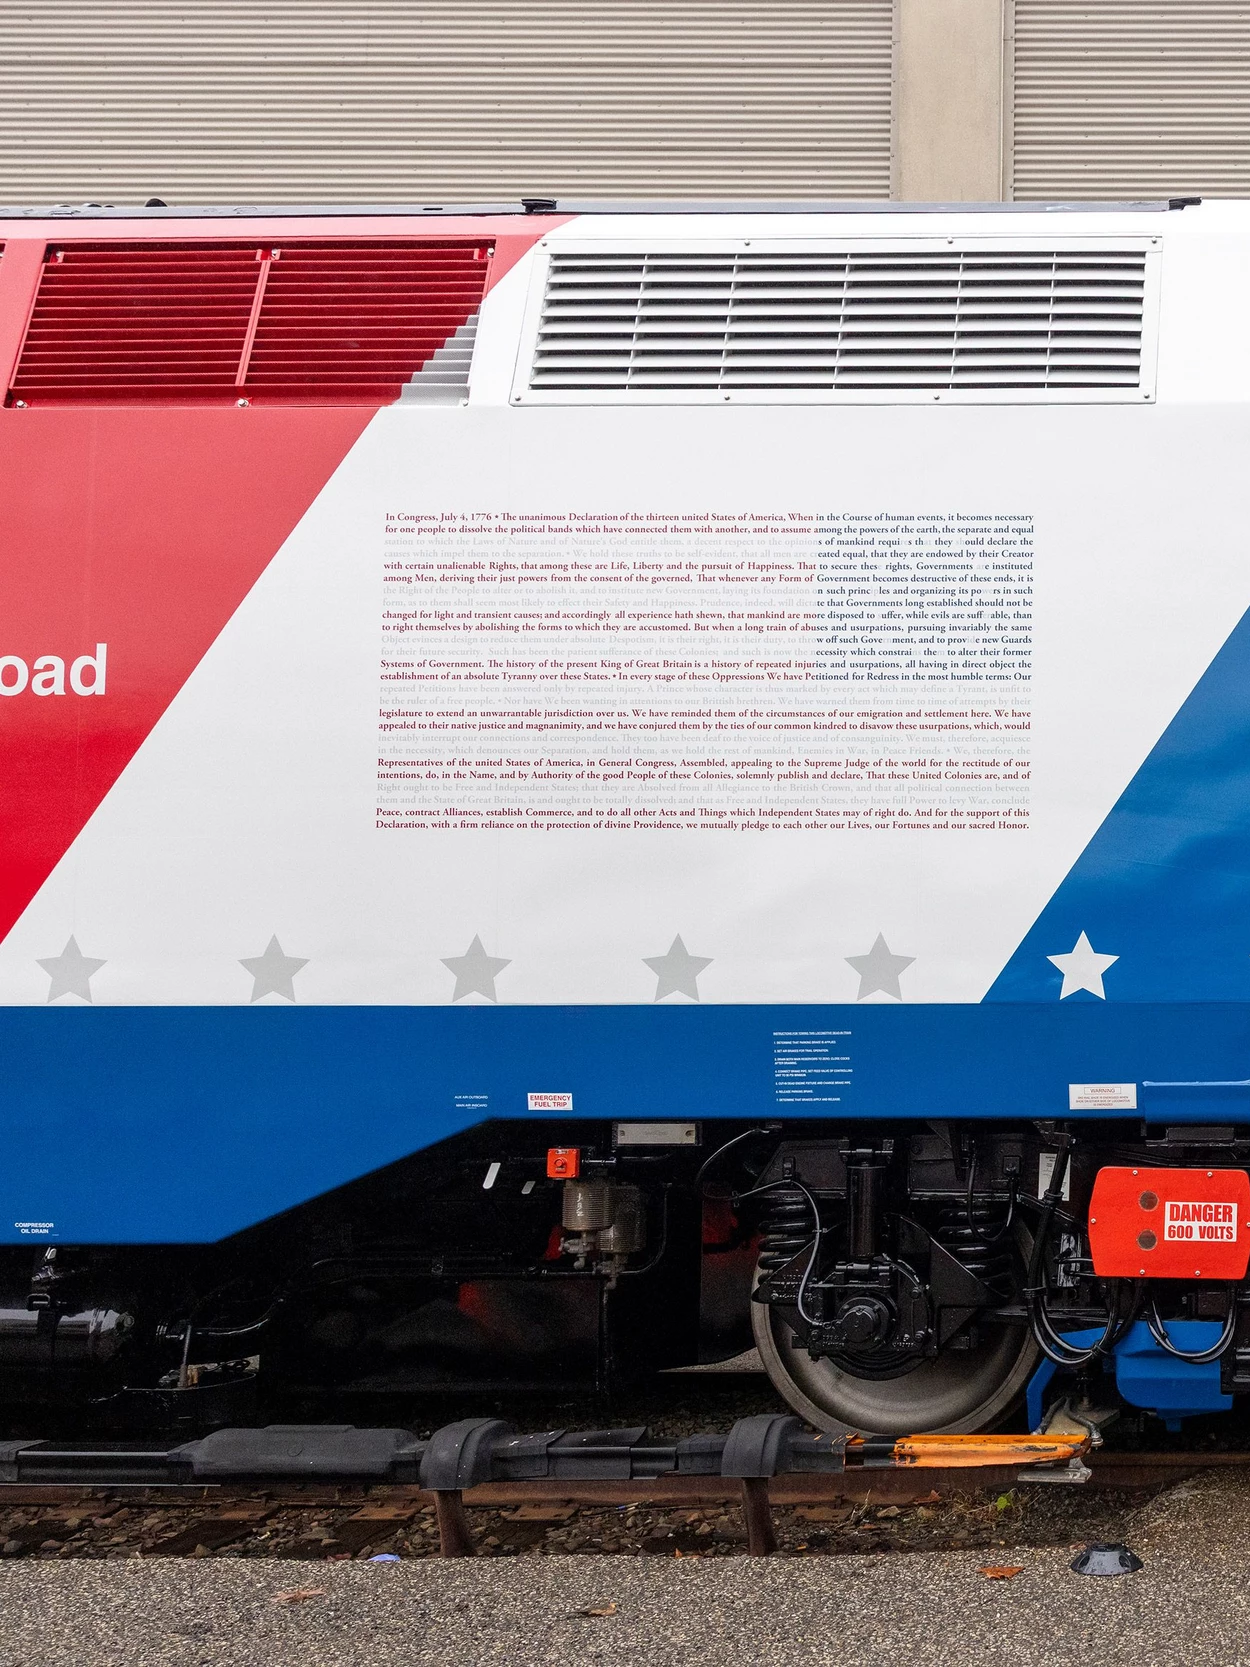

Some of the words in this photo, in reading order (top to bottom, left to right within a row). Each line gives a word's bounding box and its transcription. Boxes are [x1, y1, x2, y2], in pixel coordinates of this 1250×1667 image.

[397, 513, 438, 523] Congress,
[439, 512, 458, 523] July
[460, 513, 468, 521] 4,
[501, 512, 517, 521] The
[569, 512, 618, 521] Declaration
[619, 512, 630, 521] of
[630, 512, 644, 521] the
[646, 512, 679, 521] thirteen
[682, 512, 709, 521] united
[711, 513, 736, 521] States
[737, 512, 748, 521] of
[748, 513, 786, 522] America,
[788, 513, 813, 521] When
[816, 513, 824, 521] in
[827, 513, 840, 521] the
[842, 513, 873, 521] Course
[874, 512, 884, 521] of
[885, 513, 915, 521] human
[956, 513, 992, 521] becomes
[380, 672, 439, 680] establishment
[440, 671, 451, 680] of
[464, 672, 500, 680] absolute
[501, 672, 538, 682] Tyranny
[560, 672, 582, 680] these
[583, 672, 611, 680] States.
[619, 672, 628, 680] In
[654, 674, 676, 683] stage
[677, 672, 688, 680] of
[688, 672, 710, 680] these
[712, 672, 765, 683] Oppressions
[766, 672, 781, 680] We
[783, 672, 803, 680] have
[805, 672, 849, 681] Petitioned
[852, 672, 865, 680] for
[867, 672, 899, 681] Redress
[912, 672, 926, 681] the
[951, 672, 983, 681] humble
[1013, 672, 1032, 680] Our
[378, 758, 443, 769] Representatives
[446, 758, 457, 766] of
[458, 758, 472, 766] the
[475, 758, 503, 767] united
[505, 758, 531, 767] States
[533, 758, 544, 767] of
[545, 758, 583, 767] America,
[586, 758, 595, 767] in
[598, 758, 632, 767] General
[635, 758, 677, 770] Congress,
[680, 758, 728, 767] Assembled,
[731, 758, 773, 769] appealing
[788, 758, 801, 767] the
[804, 758, 842, 769] Supreme
[844, 758, 870, 770] Judge
[872, 758, 883, 767] of
[885, 758, 899, 767] the
[901, 758, 926, 767] world
[930, 758, 943, 767] for
[945, 758, 959, 767] the
[962, 758, 1000, 767] rectitude
[1003, 758, 1014, 767] of
[376, 820, 429, 829] Declaration,
[431, 820, 450, 828] with
[460, 820, 478, 828] firm
[481, 820, 514, 829] reliance
[530, 820, 544, 829] the
[546, 821, 591, 831] protection
[593, 820, 604, 829] of
[604, 820, 631, 829] divine
[633, 820, 684, 829] Providence,
[700, 820, 739, 831] mutually
[741, 820, 769, 832] pledge
[783, 820, 802, 829] each
[804, 820, 828, 829] other
[848, 821, 872, 830] Lives,
[892, 821, 930, 829] Fortunes
[932, 820, 949, 829] and
[969, 821, 995, 829] sacred
[998, 821, 1029, 829] Honor.
[1169, 1204, 1233, 1222] DANGER
[1168, 1225, 1193, 1239] 600
[1199, 1225, 1233, 1240] VOLTS
